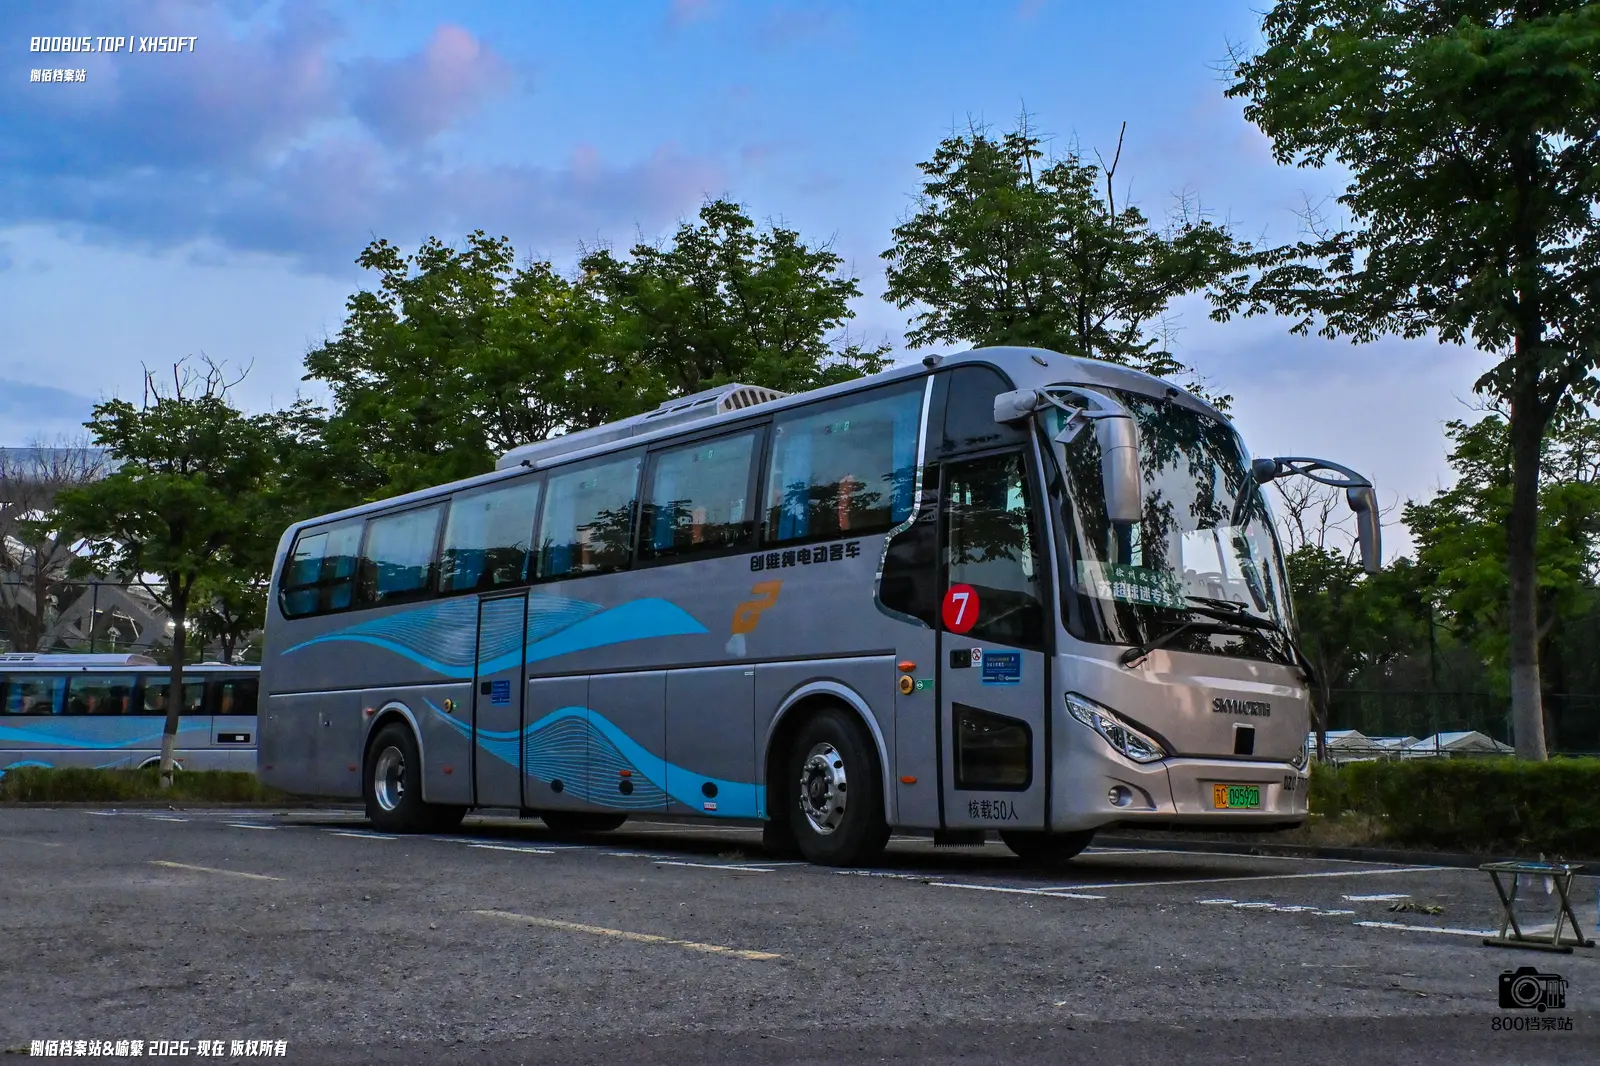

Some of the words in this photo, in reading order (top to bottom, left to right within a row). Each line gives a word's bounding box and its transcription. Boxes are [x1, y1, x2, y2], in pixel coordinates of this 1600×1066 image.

[750, 540, 861, 572] 创维纯电动客车
[952, 592, 970, 625] 7
[1212, 698, 1271, 717] SKYWORTH
[968, 799, 1019, 821] 核载50人
